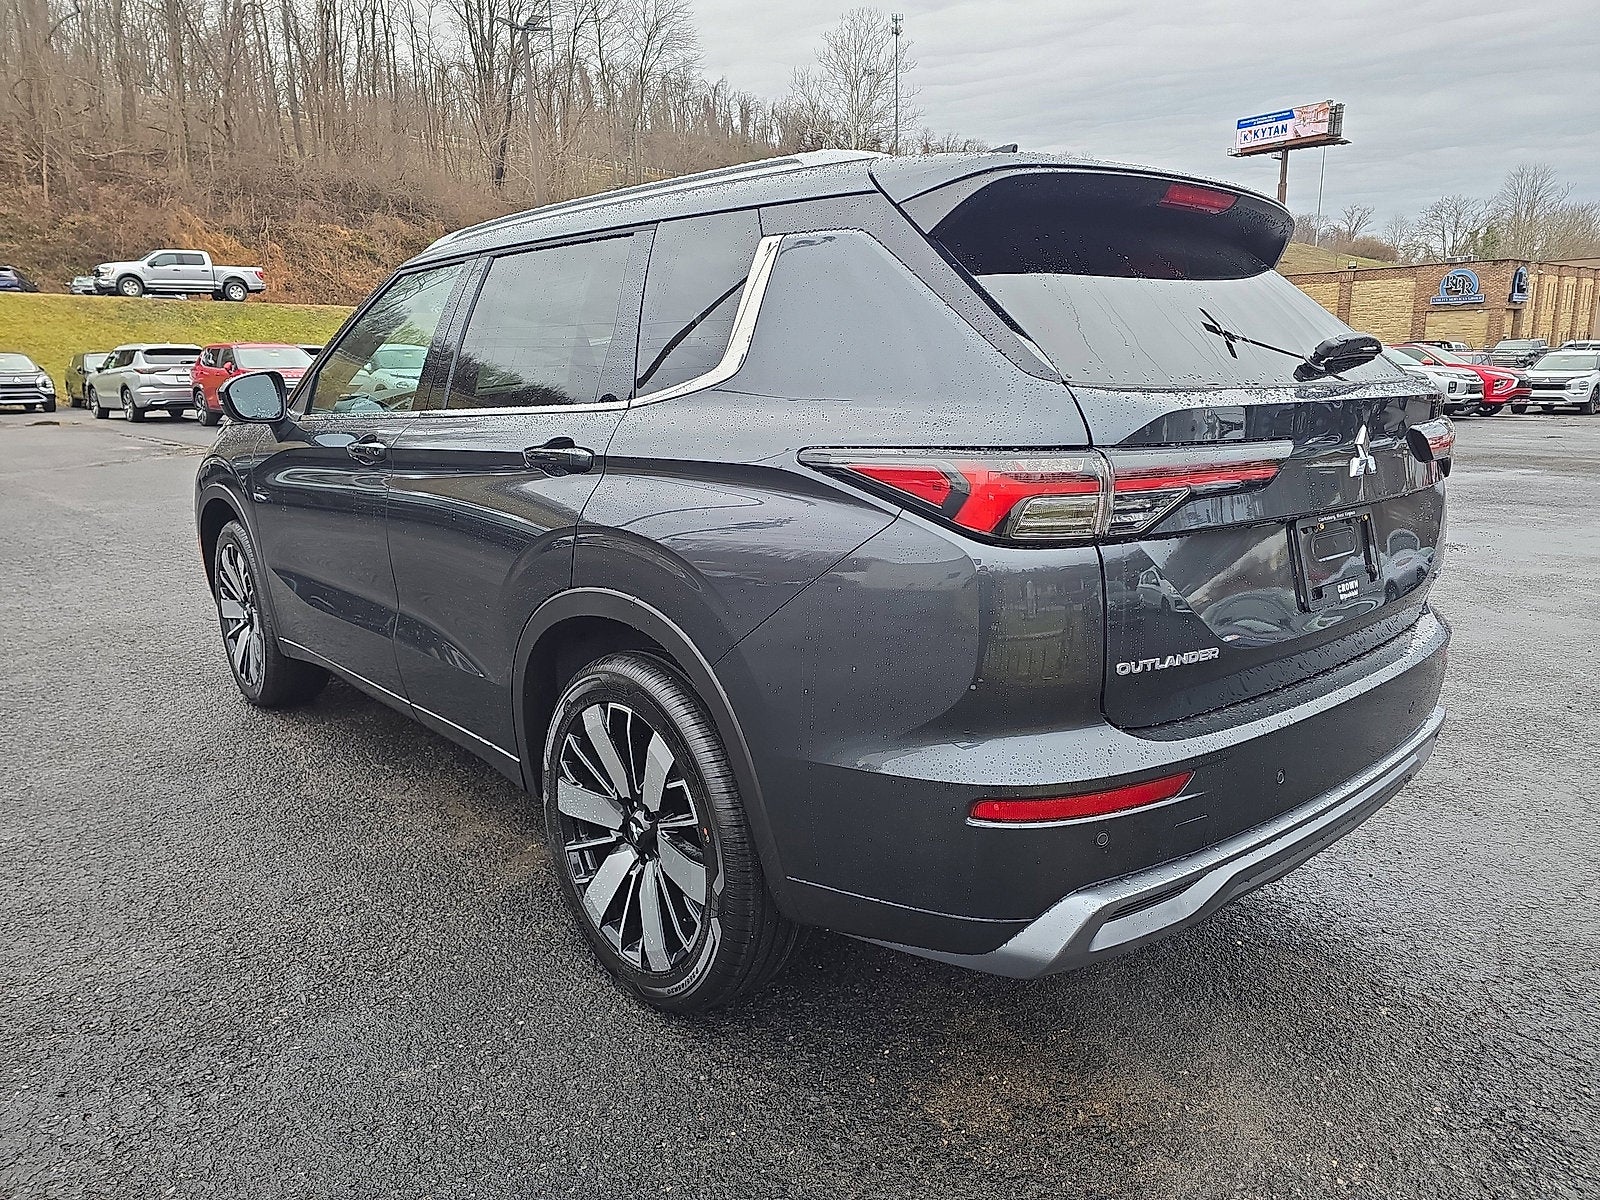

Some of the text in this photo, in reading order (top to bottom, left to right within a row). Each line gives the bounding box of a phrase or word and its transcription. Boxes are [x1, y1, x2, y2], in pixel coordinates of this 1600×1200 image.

[1253, 124, 1288, 139] KYTAN
[1337, 580, 1359, 594] CROWN
[1115, 647, 1220, 675] OUTLANDER
